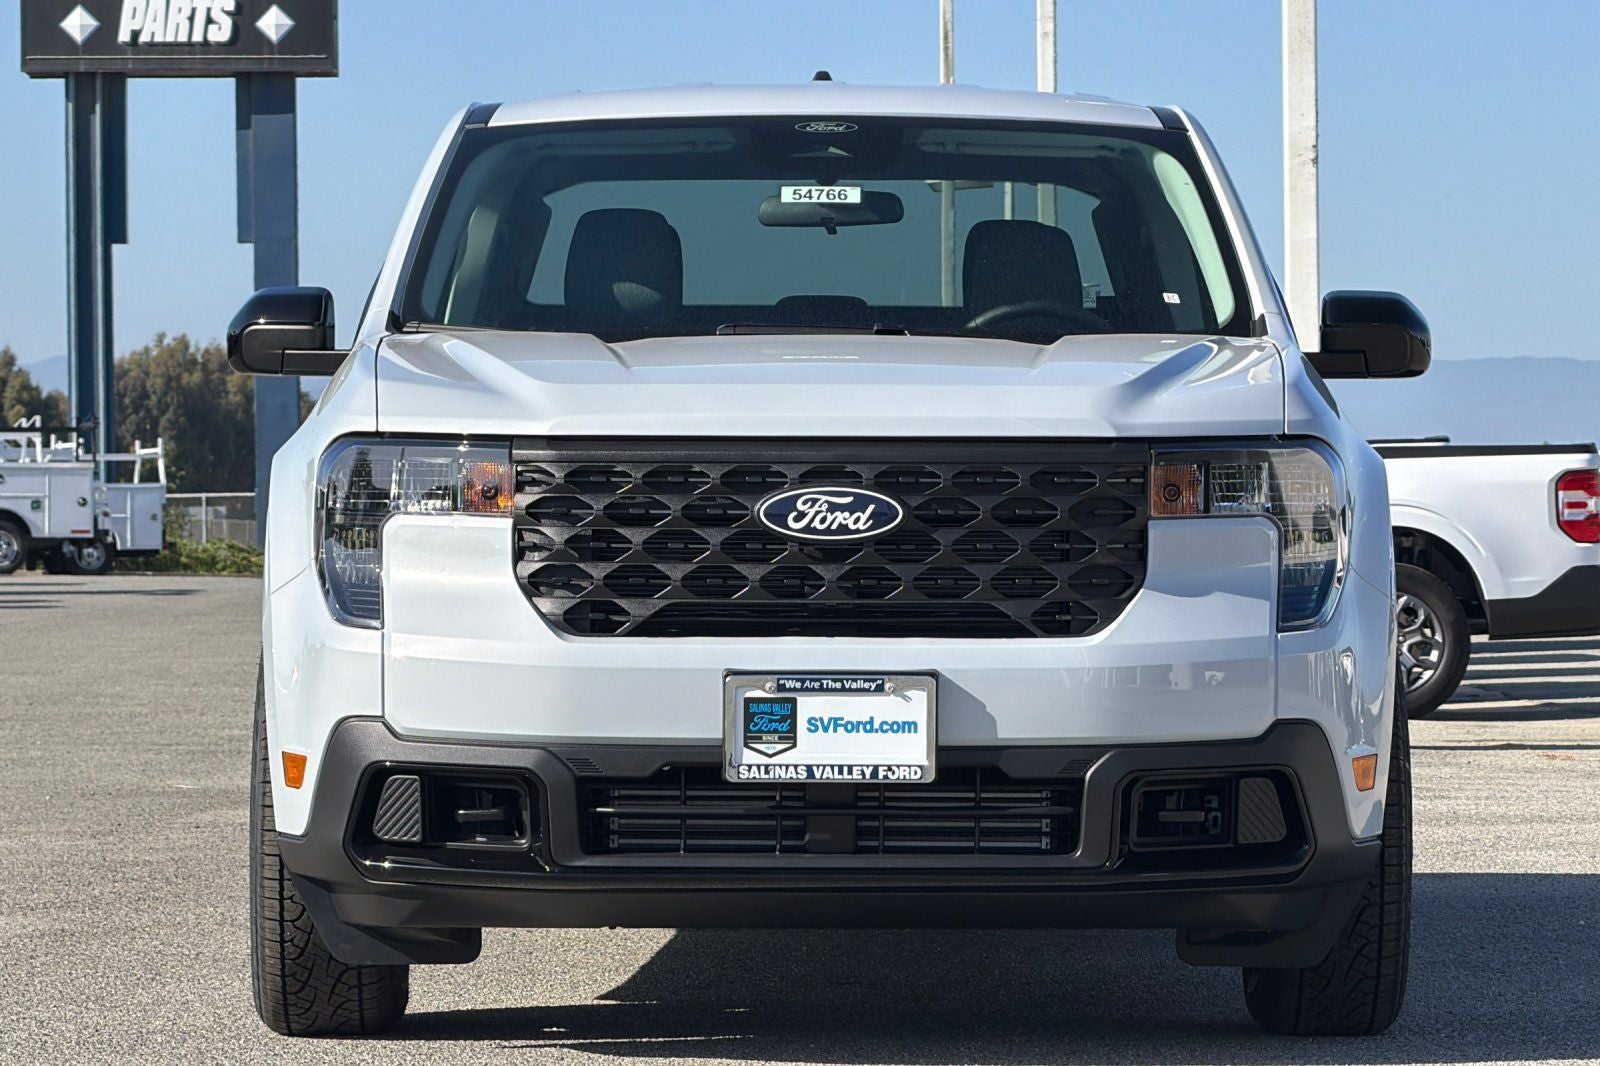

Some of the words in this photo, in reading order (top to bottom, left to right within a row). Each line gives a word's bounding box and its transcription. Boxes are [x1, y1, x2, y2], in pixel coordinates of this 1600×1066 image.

[117, 0, 236, 43] PARTS
[806, 122, 846, 132] Ford
[792, 189, 848, 201] 54766
[787, 494, 876, 530] Ford
[803, 679, 820, 689] Are
[821, 679, 842, 689] The
[749, 703, 771, 713] SALINAS
[773, 703, 791, 714] VALLEY
[750, 714, 791, 731] Ford
[806, 716, 918, 733] SVFord.com
[738, 765, 807, 779] SALINAS
[813, 765, 873, 779] VALLEY
[879, 765, 922, 779] FORD
